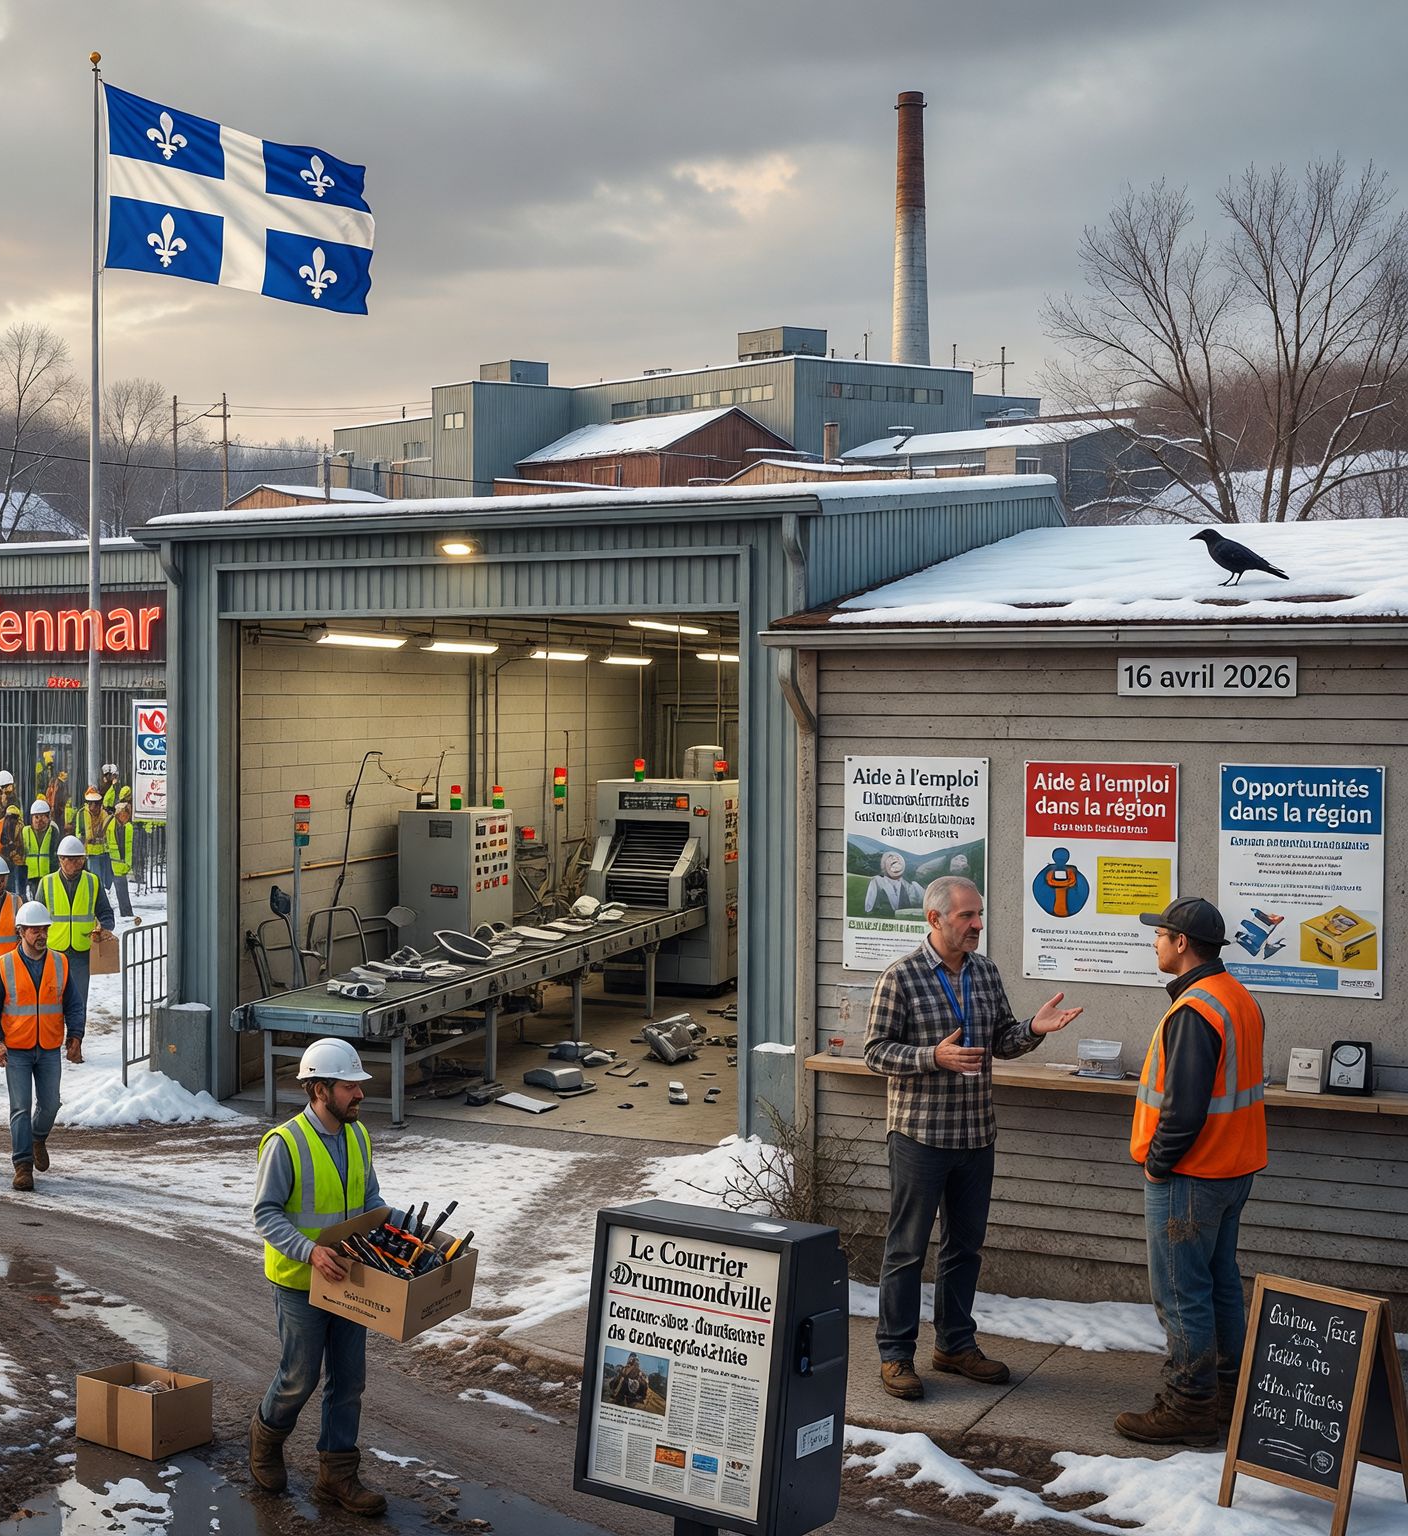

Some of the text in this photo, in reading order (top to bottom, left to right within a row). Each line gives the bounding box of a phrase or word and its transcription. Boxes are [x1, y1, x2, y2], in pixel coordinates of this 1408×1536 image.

[1124, 664, 1291, 689] 16 avril 2026
[852, 768, 979, 791] Aide à l'emploi
[1033, 772, 1170, 798] Aide à l'emploi
[1231, 776, 1370, 800] Opportunités
[1035, 796, 1166, 821] dans la région
[1229, 801, 1372, 828] dans la région
[628, 1234, 748, 1278] Le Courrier
[609, 1261, 772, 1312] Drummondville
